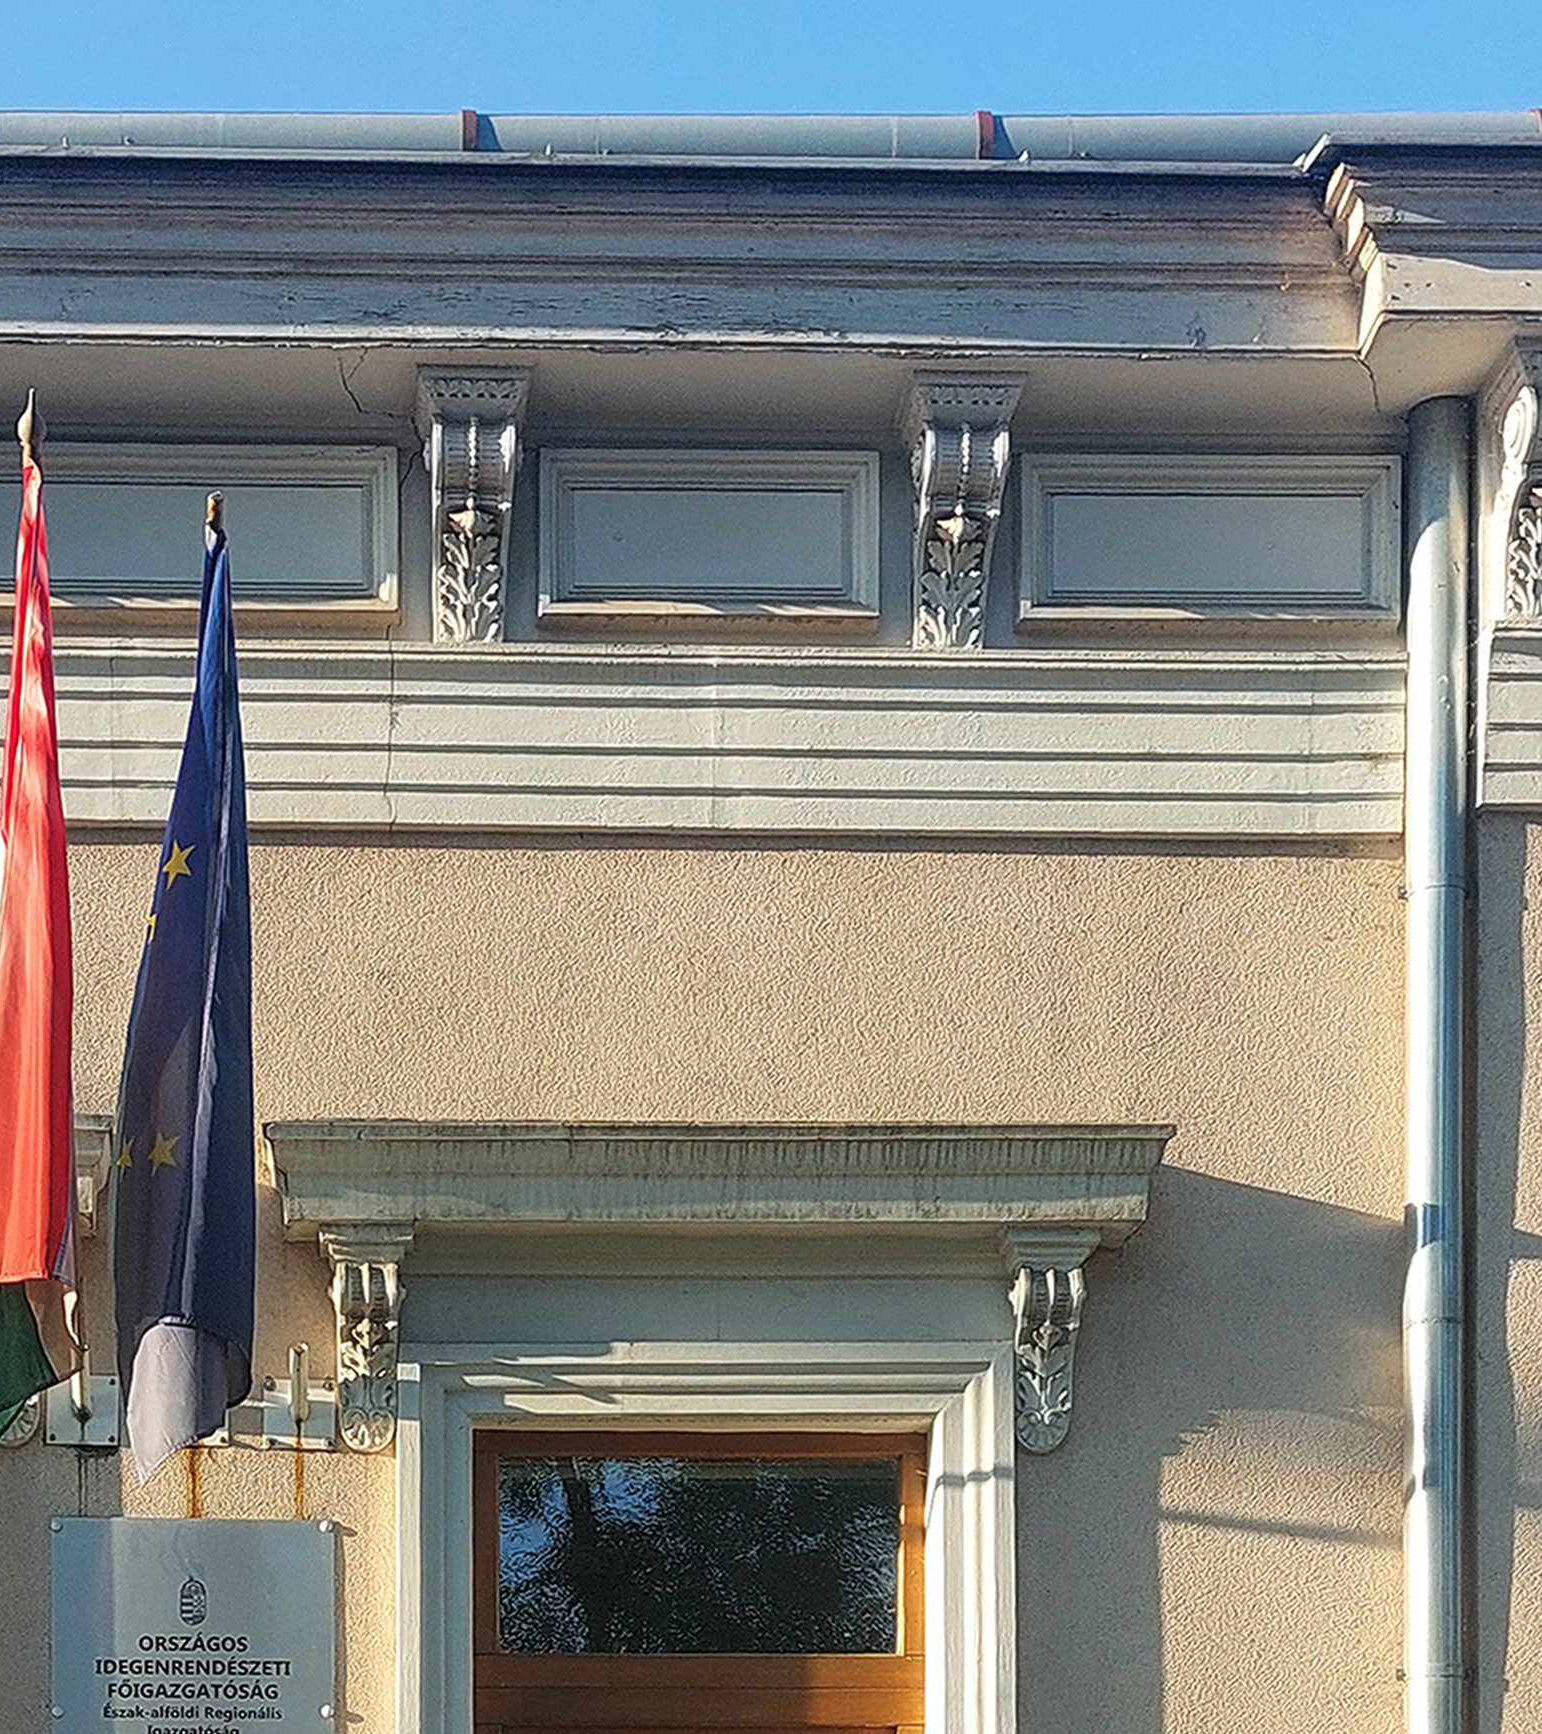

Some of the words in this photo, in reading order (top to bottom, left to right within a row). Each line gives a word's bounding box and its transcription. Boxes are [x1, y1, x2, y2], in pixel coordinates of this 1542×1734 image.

[138, 1631, 249, 1652] ORSZÁGOS
[94, 1656, 291, 1676] IDEGENRENDÉSZETI
[107, 1679, 279, 1699] FŐIGAZGATÓSÁG
[103, 1702, 200, 1719] Észak-alföldi
[204, 1705, 283, 1722] Regionális
